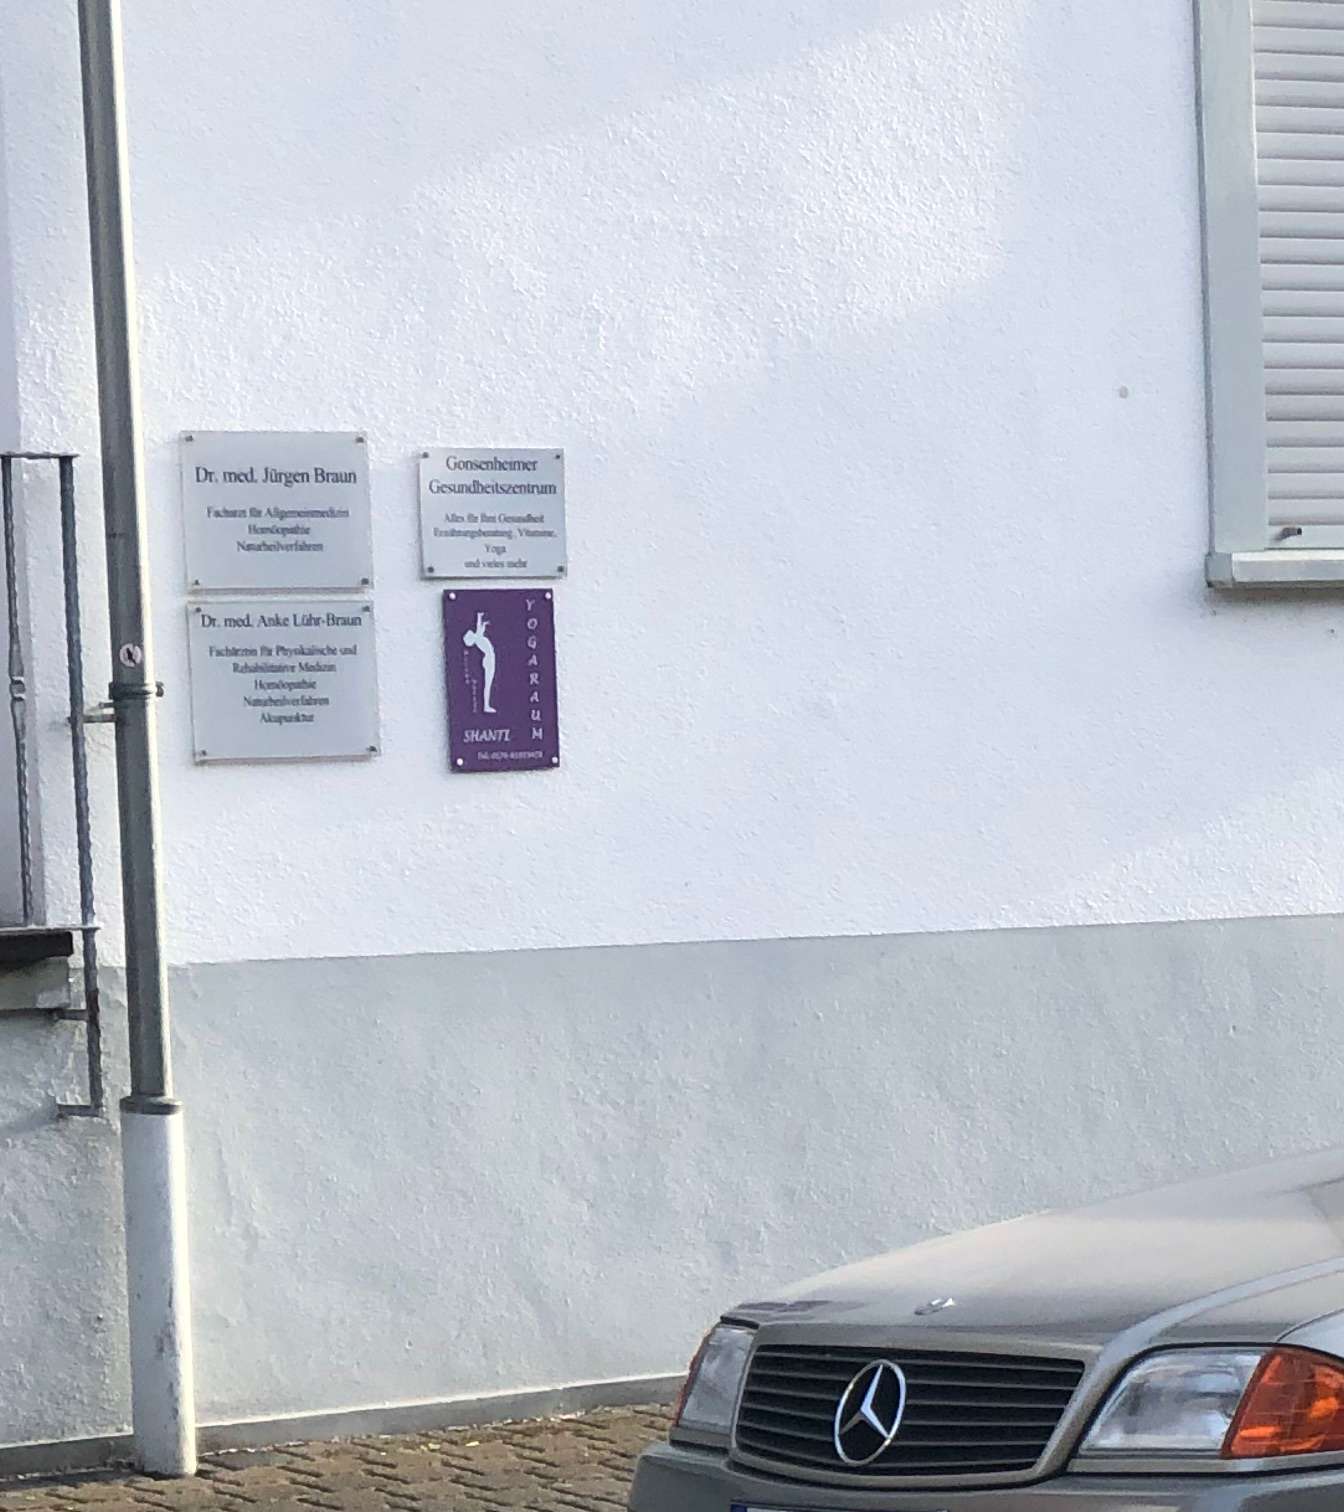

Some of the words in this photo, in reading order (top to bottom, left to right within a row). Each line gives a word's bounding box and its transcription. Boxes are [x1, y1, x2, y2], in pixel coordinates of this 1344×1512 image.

[445, 455, 538, 472] Gonsenheimer
[195, 466, 218, 484] Dr.
[223, 466, 258, 484] med.
[262, 466, 310, 488] Jürgen
[313, 466, 358, 484] Braun
[428, 478, 557, 495] Gesundheitszentrum
[200, 613, 221, 628] Dr.
[224, 613, 252, 628] med.
[257, 613, 290, 628] Anke
[293, 612, 362, 628] Lühr-Braun
